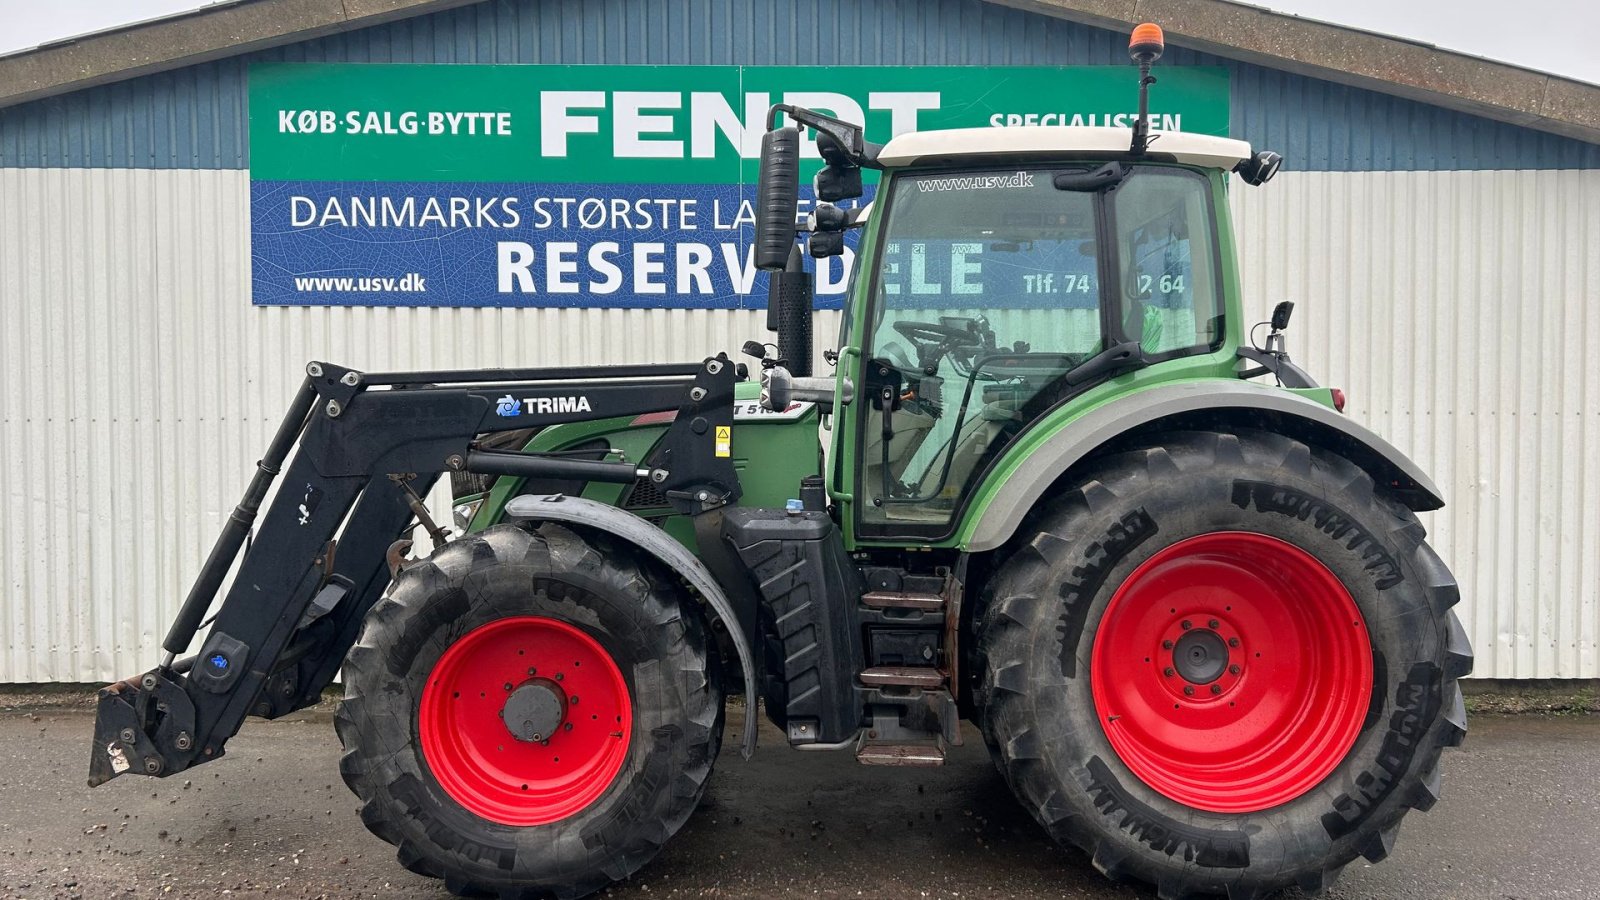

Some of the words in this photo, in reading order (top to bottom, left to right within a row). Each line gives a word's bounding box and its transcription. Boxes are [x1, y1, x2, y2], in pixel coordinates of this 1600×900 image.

[541, 91, 941, 158] FENDT
[917, 171, 1034, 192] www.usv.dk
[291, 196, 520, 229] DANMARKS
[533, 197, 699, 231] STØRSTE
[713, 199, 834, 230] LAE
[497, 241, 983, 295] RESERVDLE
[294, 273, 426, 293] www.usv.dk
[1023, 273, 1058, 293] Tlf.
[1064, 274, 1090, 293] 74
[1159, 274, 1185, 293] 64
[523, 396, 592, 414] TRIMA
